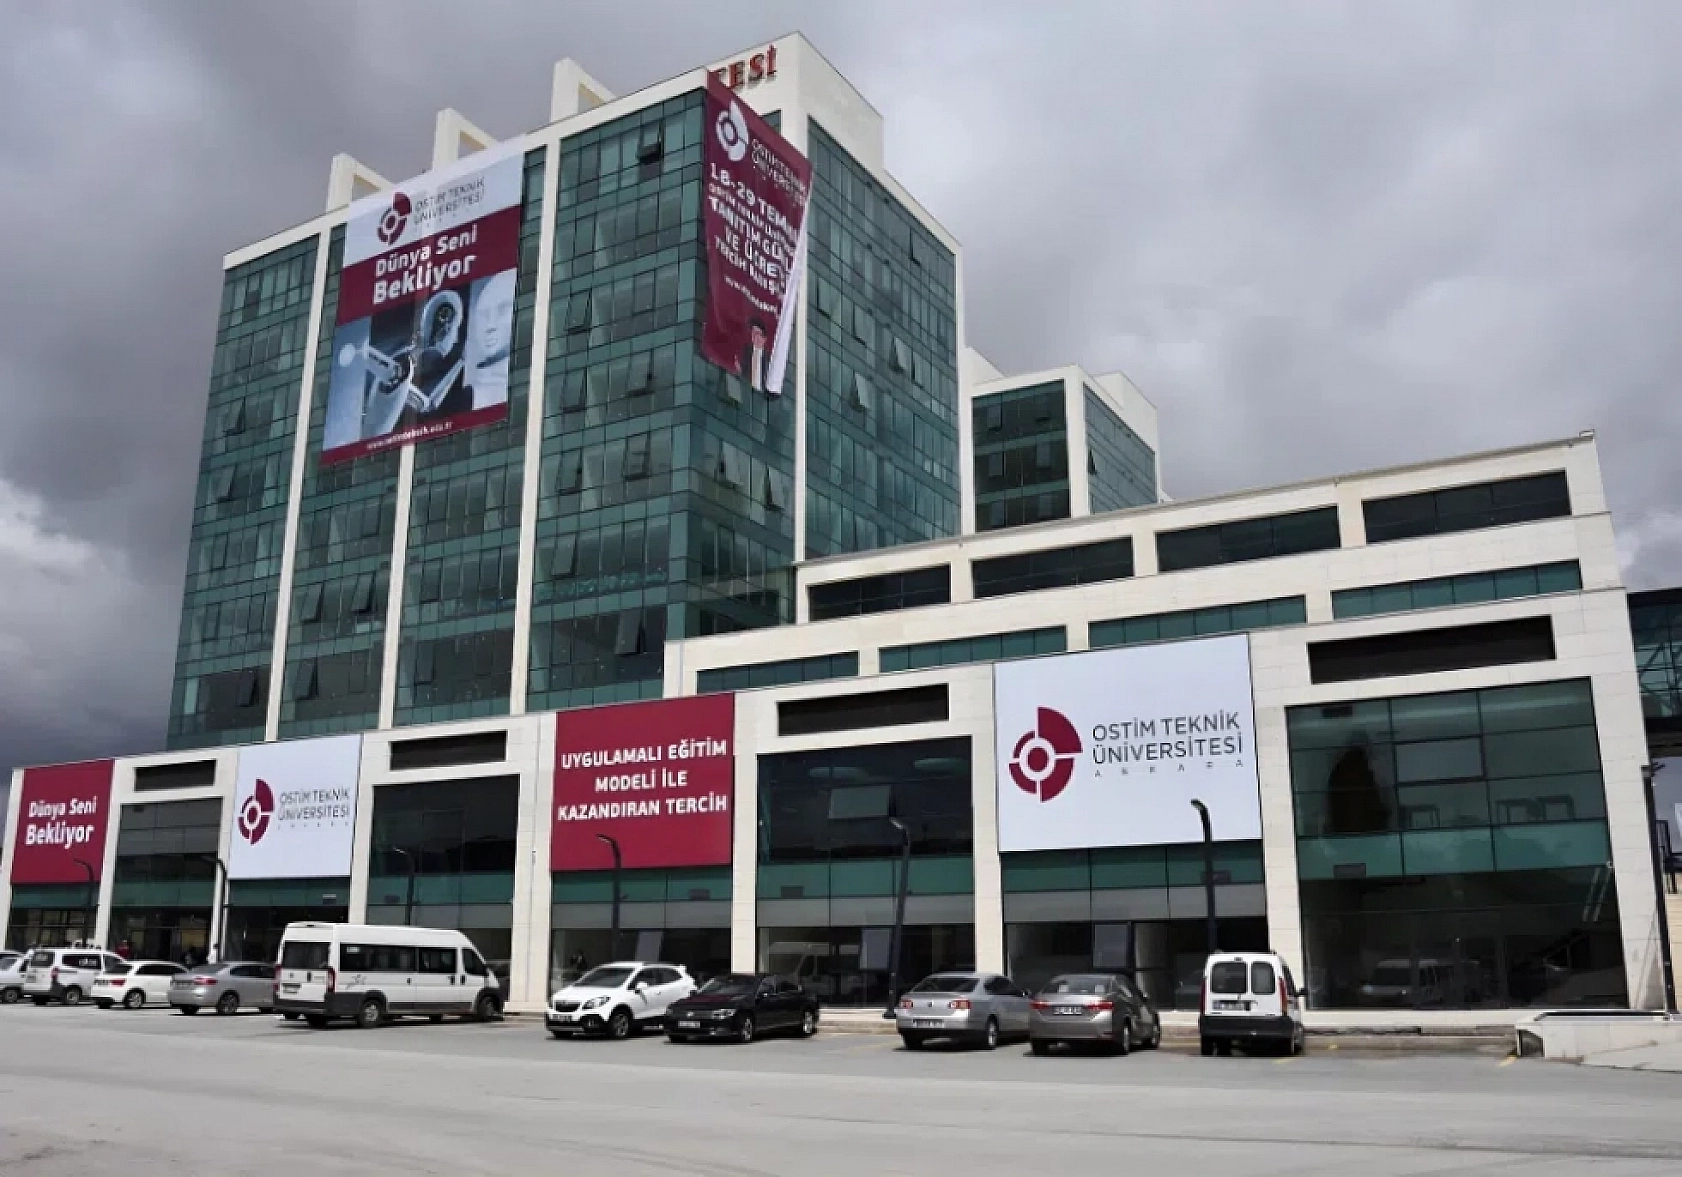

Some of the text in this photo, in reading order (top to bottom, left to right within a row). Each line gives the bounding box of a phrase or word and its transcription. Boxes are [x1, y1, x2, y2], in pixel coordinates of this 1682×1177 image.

[376, 223, 478, 278] Dünya Seni
[373, 255, 478, 305] Bekliyor
[1092, 708, 1241, 742] OSTİM TEKNİK
[561, 736, 727, 769] UYGULAMALI EĞİTİM
[1092, 731, 1243, 764] ÜNİVERSİTESİ
[595, 766, 688, 792] MODELİ İLE
[28, 795, 98, 820] Dünya Seni
[557, 791, 727, 821] KAZANDIRAN TERCİH
[25, 820, 95, 849] Bekliyor
